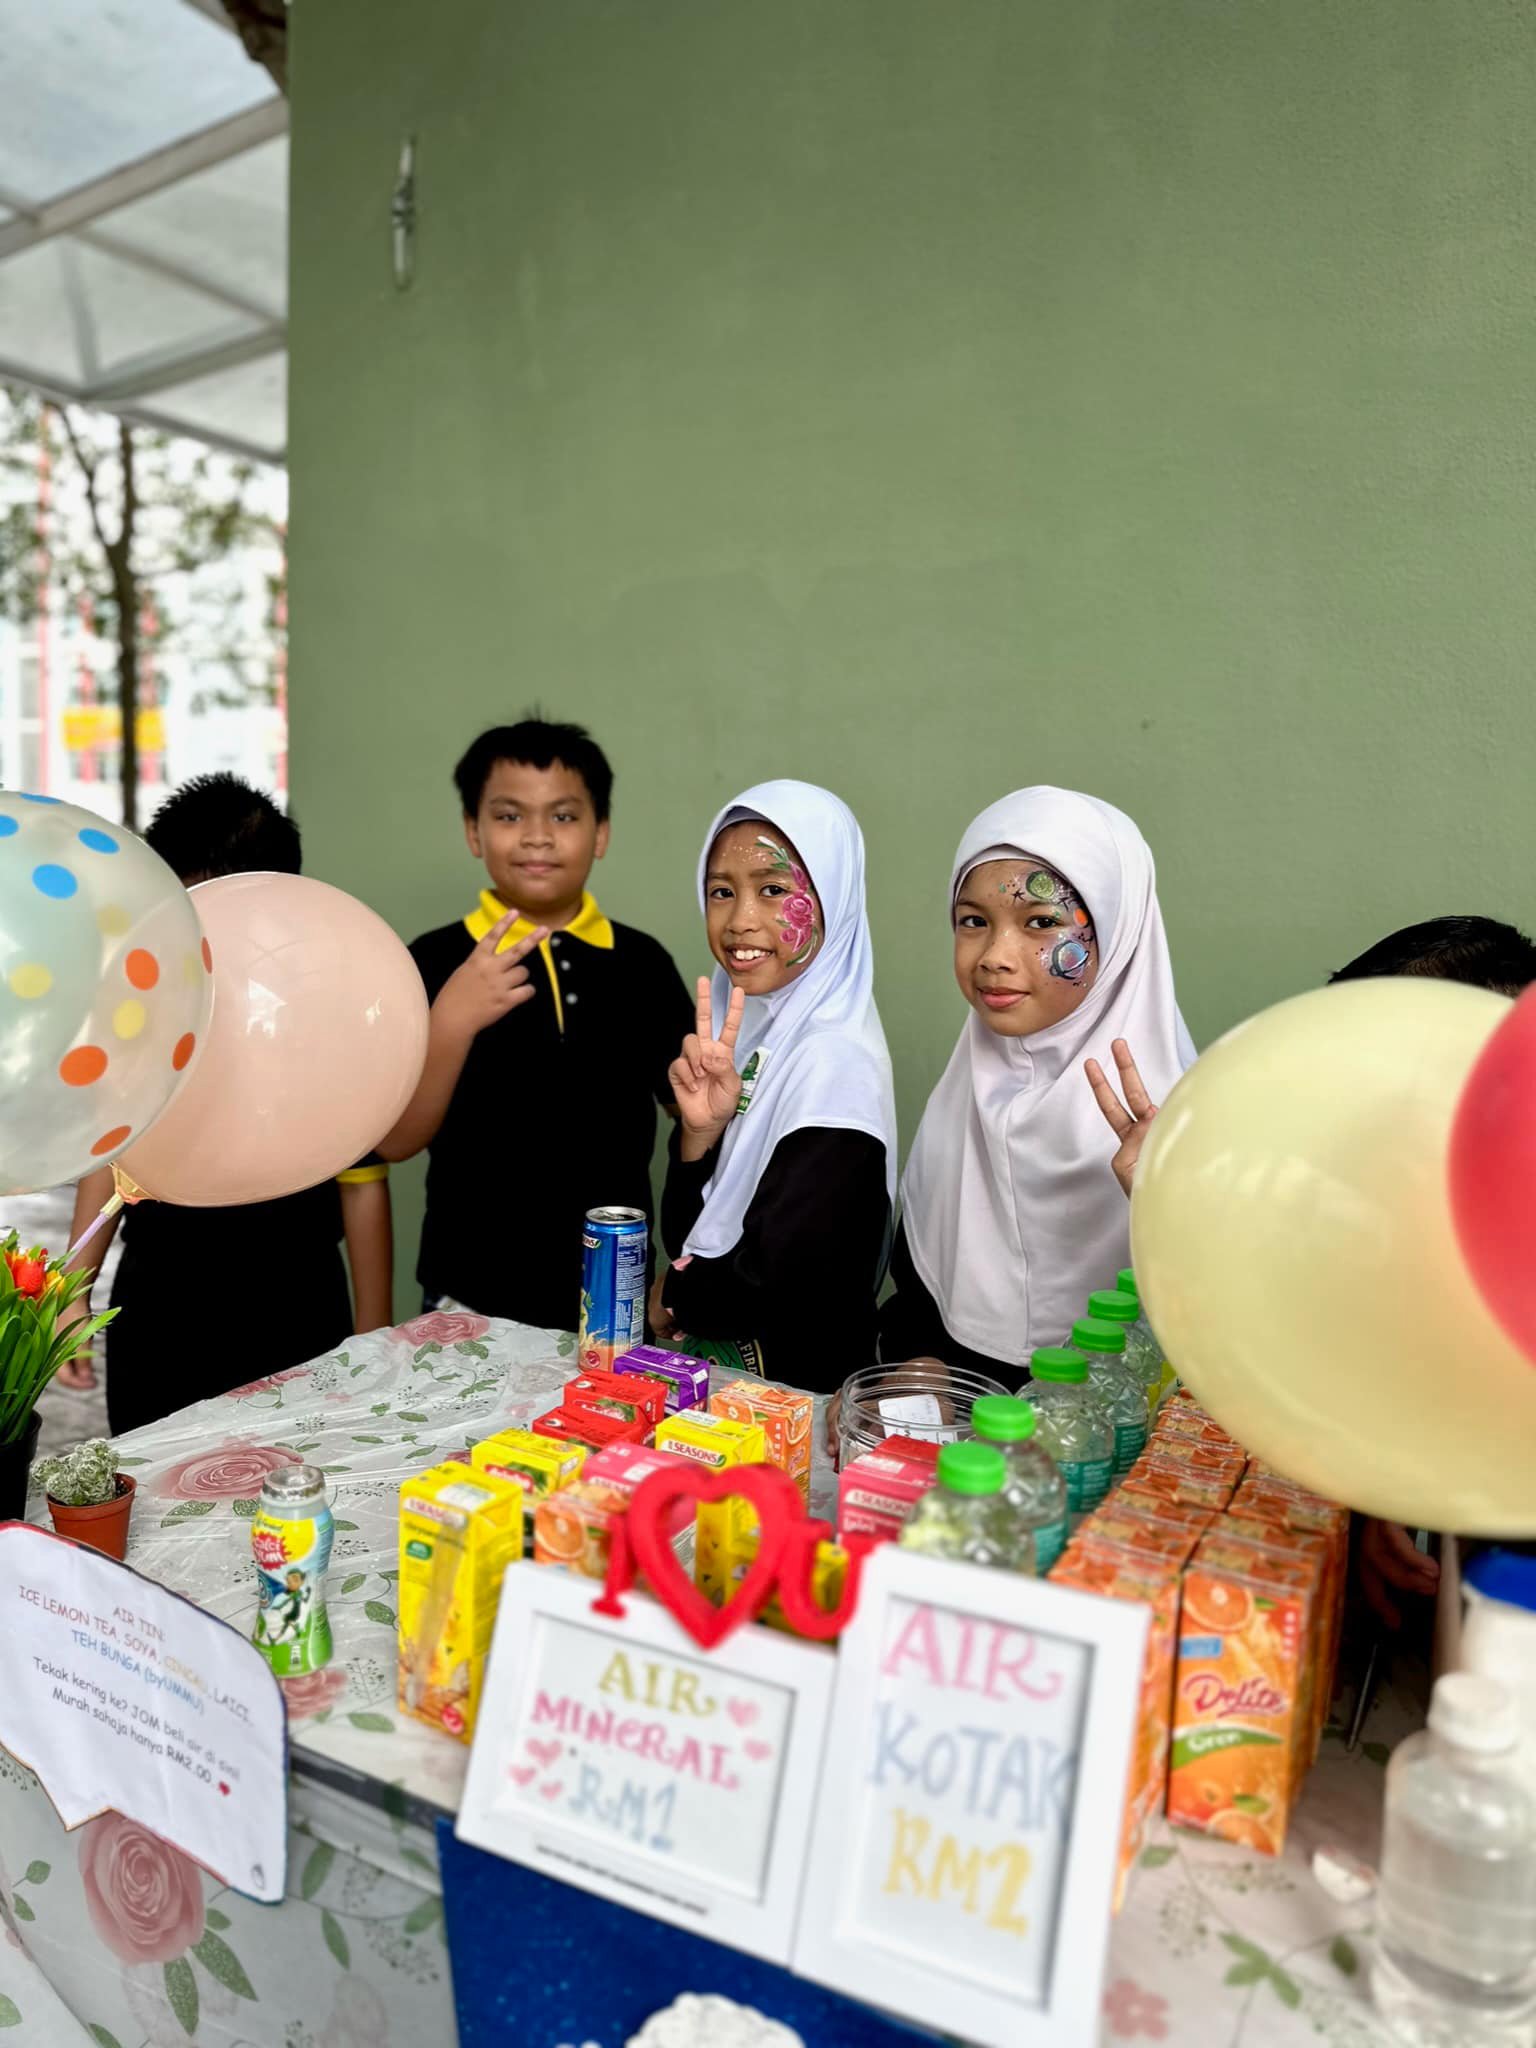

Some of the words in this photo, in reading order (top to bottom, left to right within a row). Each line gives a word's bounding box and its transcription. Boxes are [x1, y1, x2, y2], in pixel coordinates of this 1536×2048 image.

[674, 1441, 717, 1463] SEASONS
[19, 1585, 40, 1606] ICE
[43, 1594, 90, 1626] LEMON
[113, 1607, 135, 1627] AIR
[72, 1629, 97, 1652] TEH
[101, 1641, 141, 1676] BUNGA
[599, 1651, 719, 1718] AIR
[881, 1603, 1064, 1702] AIR
[33, 1656, 69, 1682] Tekak
[72, 1672, 106, 1705] kering
[131, 1705, 160, 1731] JOM
[52, 1687, 90, 1713] Murah
[93, 1708, 128, 1735] sahaja
[130, 1725, 163, 1754] hanya
[865, 1699, 1078, 1842] KOTAK
[567, 1763, 677, 1852] RM1
[882, 1808, 1033, 1937] RM2
